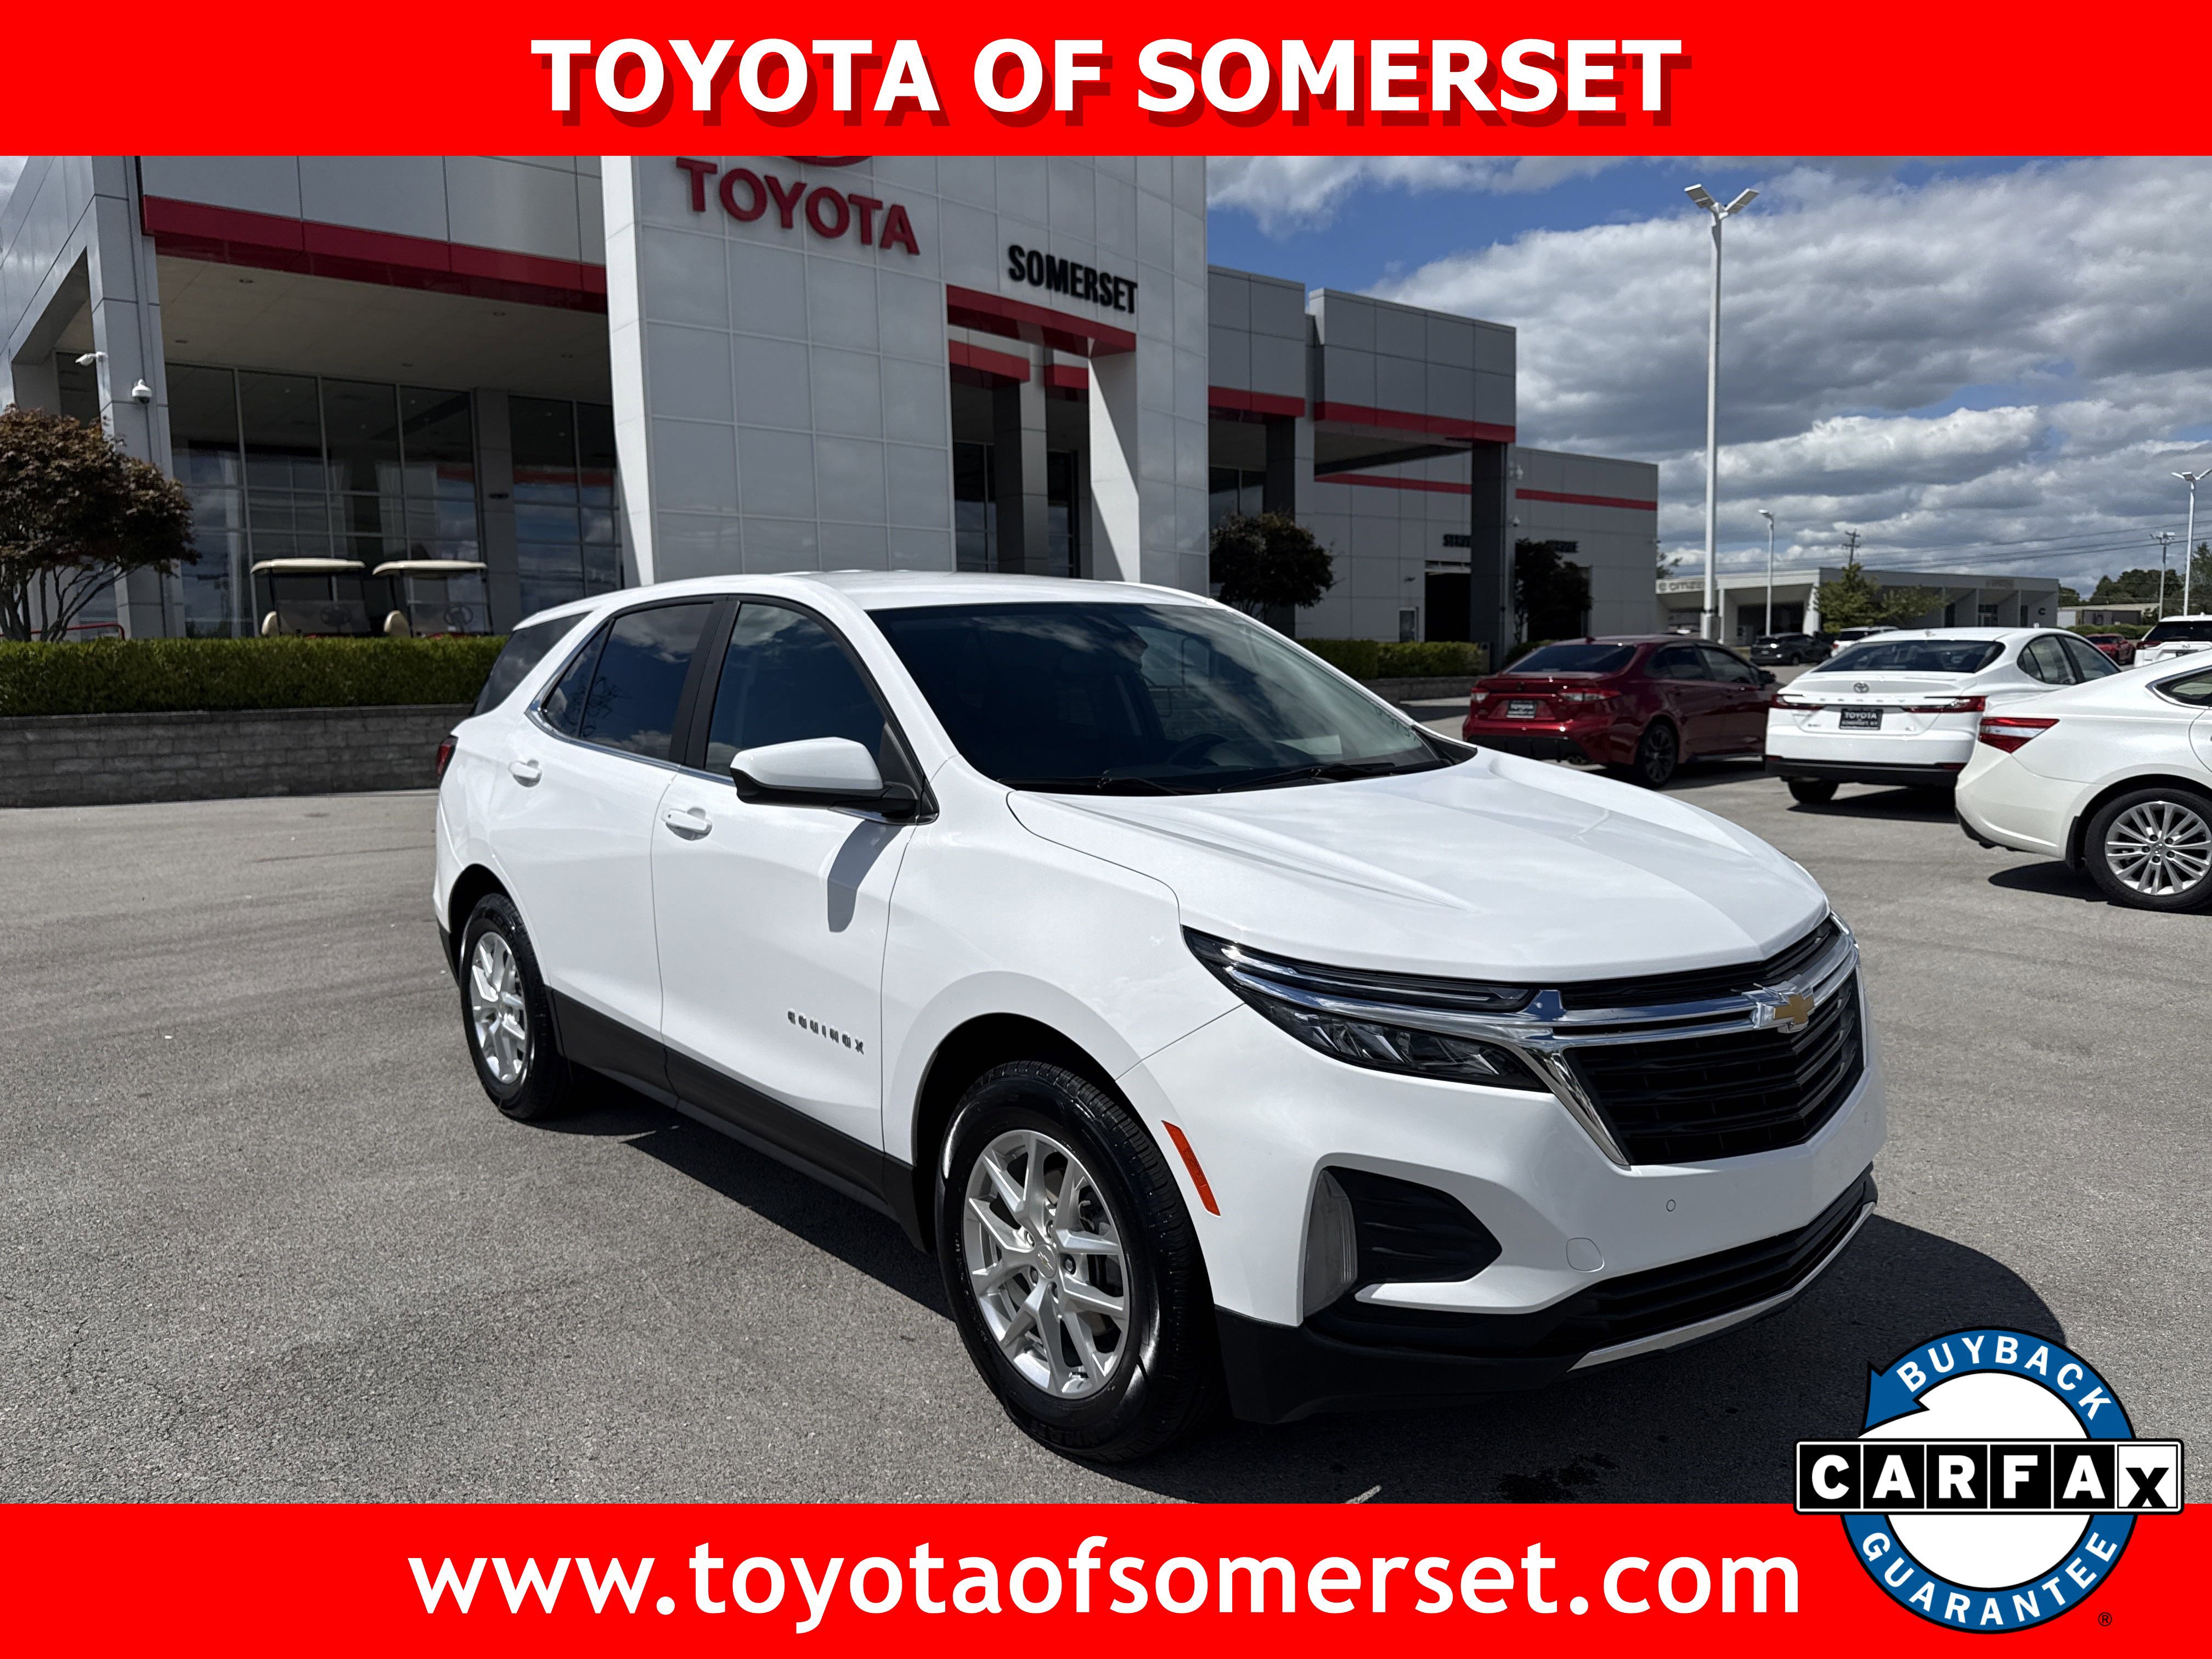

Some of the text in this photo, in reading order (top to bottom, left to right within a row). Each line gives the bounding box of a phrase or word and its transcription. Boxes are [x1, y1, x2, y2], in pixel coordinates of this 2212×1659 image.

[676, 157, 920, 256] TOYOTA
[1008, 245, 1138, 314] SOMERSET
[1844, 711, 1877, 719] TOYOTA
[787, 1008, 865, 1055] EQUINOX
